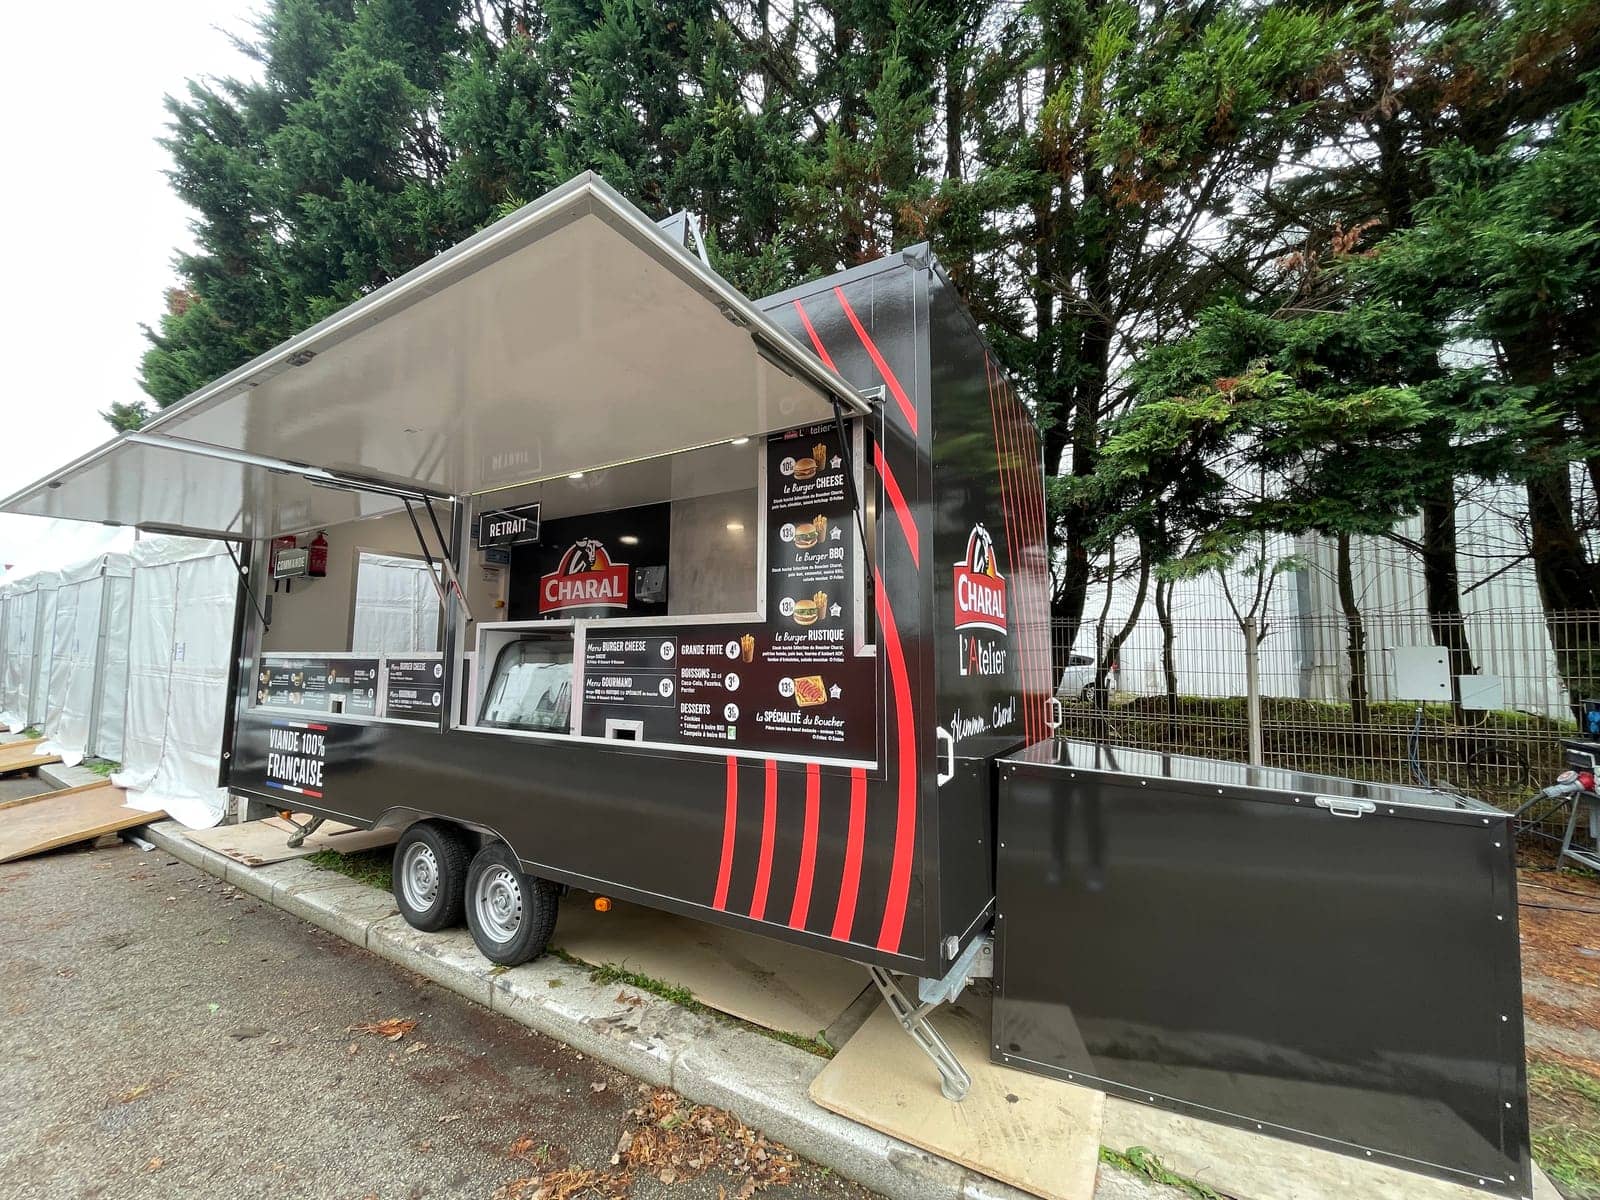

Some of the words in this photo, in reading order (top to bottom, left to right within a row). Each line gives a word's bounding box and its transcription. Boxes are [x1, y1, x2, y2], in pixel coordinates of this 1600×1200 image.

[783, 484, 791, 494] Le
[792, 482, 816, 495] Burger
[816, 474, 844, 489] CHEESE
[489, 518, 528, 538] RETRAIT
[795, 553, 803, 562] Le
[804, 552, 829, 564] Burger
[829, 547, 844, 560] BBQ
[545, 575, 624, 603] CHARAL
[958, 574, 1005, 619] CHARAL
[587, 643, 602, 652] Menu
[602, 641, 624, 652] BURGER
[624, 640, 646, 652] CHEESE
[775, 631, 782, 641] Le
[783, 631, 808, 645] Burger
[808, 629, 844, 643] RUSTIQUE
[681, 645, 705, 655] GRANDE
[706, 645, 723, 655] FRITE
[959, 634, 1007, 676] L'Atelier
[586, 678, 602, 687] Menu
[601, 677, 633, 688] GOURMAND
[681, 668, 710, 679] BOISSONS
[681, 703, 711, 714] DESSERTS
[756, 711, 764, 722] La
[764, 709, 801, 724] SPÉCIALITÉ
[803, 715, 813, 725] du
[814, 716, 845, 727] Boucher
[269, 728, 300, 752] VIANDE
[302, 732, 326, 757] 100%
[266, 752, 325, 788] FRANÇAISE
